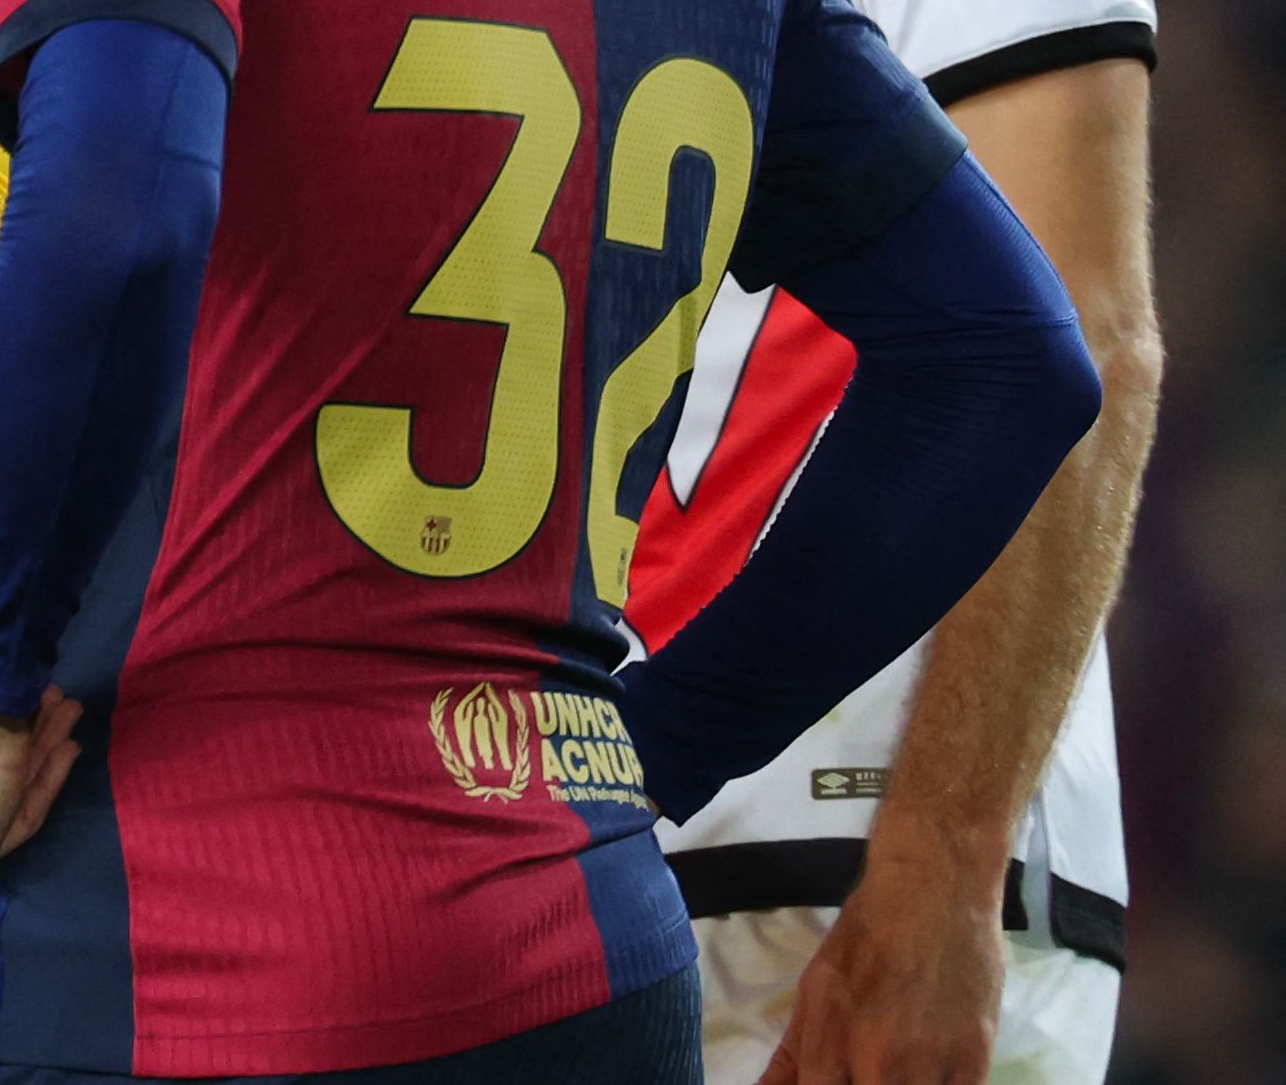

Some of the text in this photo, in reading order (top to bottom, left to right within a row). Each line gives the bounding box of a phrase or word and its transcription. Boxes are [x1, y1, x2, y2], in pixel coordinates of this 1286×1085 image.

[313, 14, 756, 612] 32
[530, 691, 634, 747] UNHCR
[541, 738, 645, 791] ACNUR
